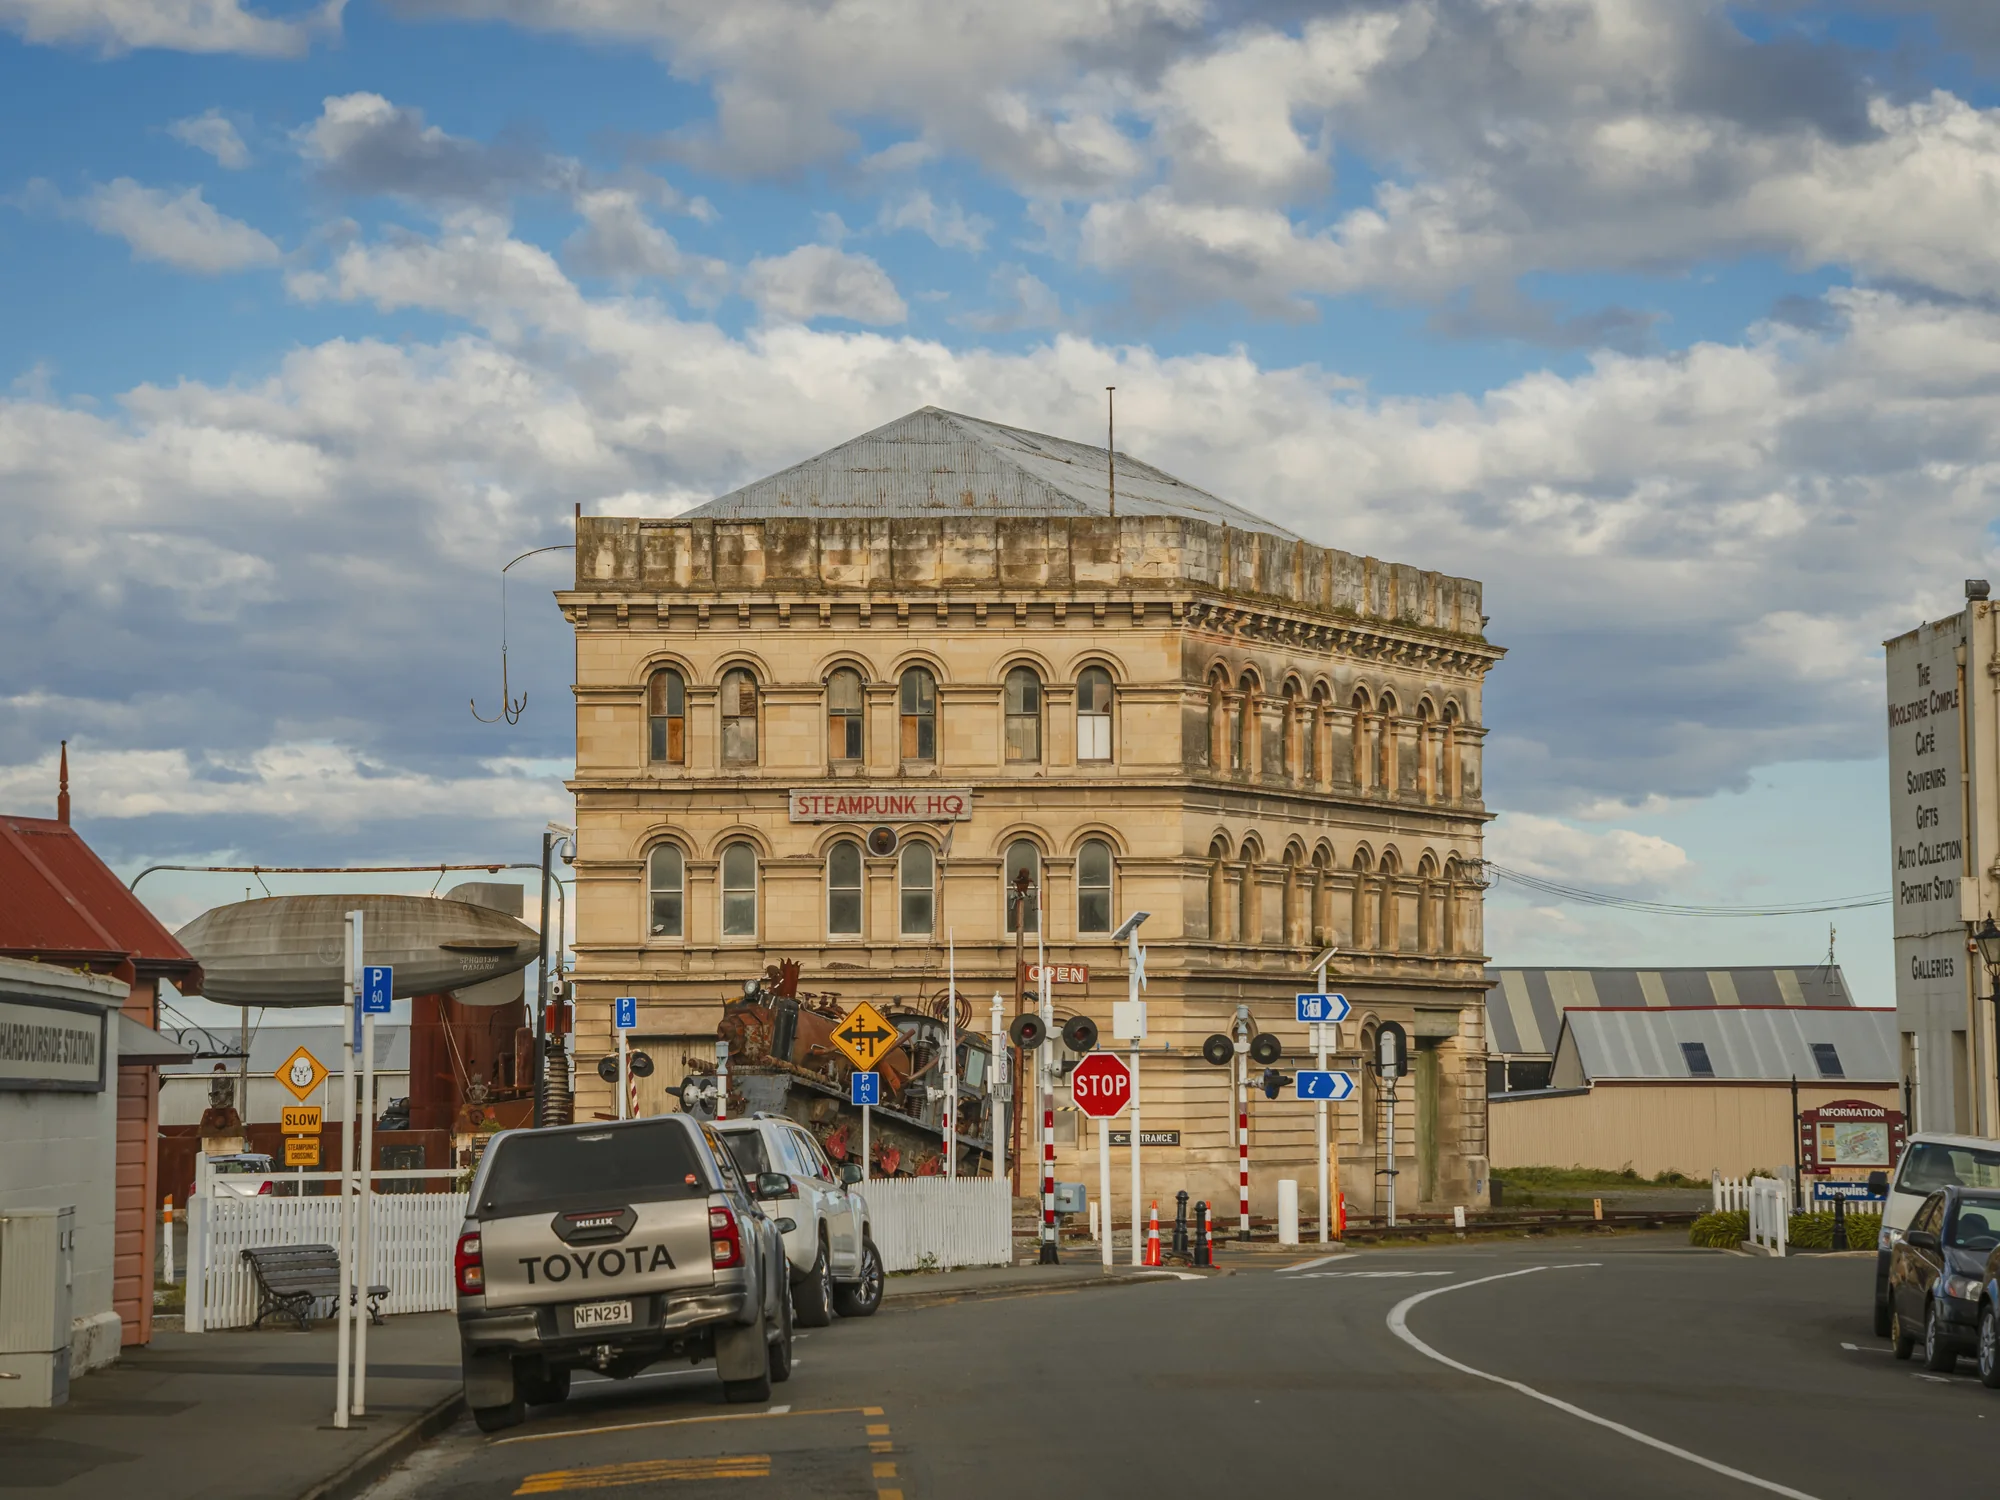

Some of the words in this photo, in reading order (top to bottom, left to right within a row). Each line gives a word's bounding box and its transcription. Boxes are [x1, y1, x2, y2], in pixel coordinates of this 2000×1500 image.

[1930, 688, 1959, 715] COMPLE
[798, 795, 916, 814] STEAMPUNK
[927, 795, 963, 814] HQ
[372, 969, 383, 987] P
[1028, 965, 1084, 983] OPEN
[371, 990, 383, 1003] 60
[622, 999, 630, 1012] P
[622, 1012, 631, 1022] 60
[0, 1022, 62, 1063] HARBOURSIDE
[64, 1029, 96, 1066] STATION
[861, 1074, 869, 1083] P
[1076, 1074, 1127, 1097] STOP
[860, 1083, 871, 1092] 60
[285, 1113, 319, 1126] SLOW
[1819, 1108, 1885, 1117] INFORMATION
[1140, 1133, 1173, 1142] TRANCE
[518, 1244, 677, 1285] TOYOTA
[575, 1305, 629, 1324] NFN291
